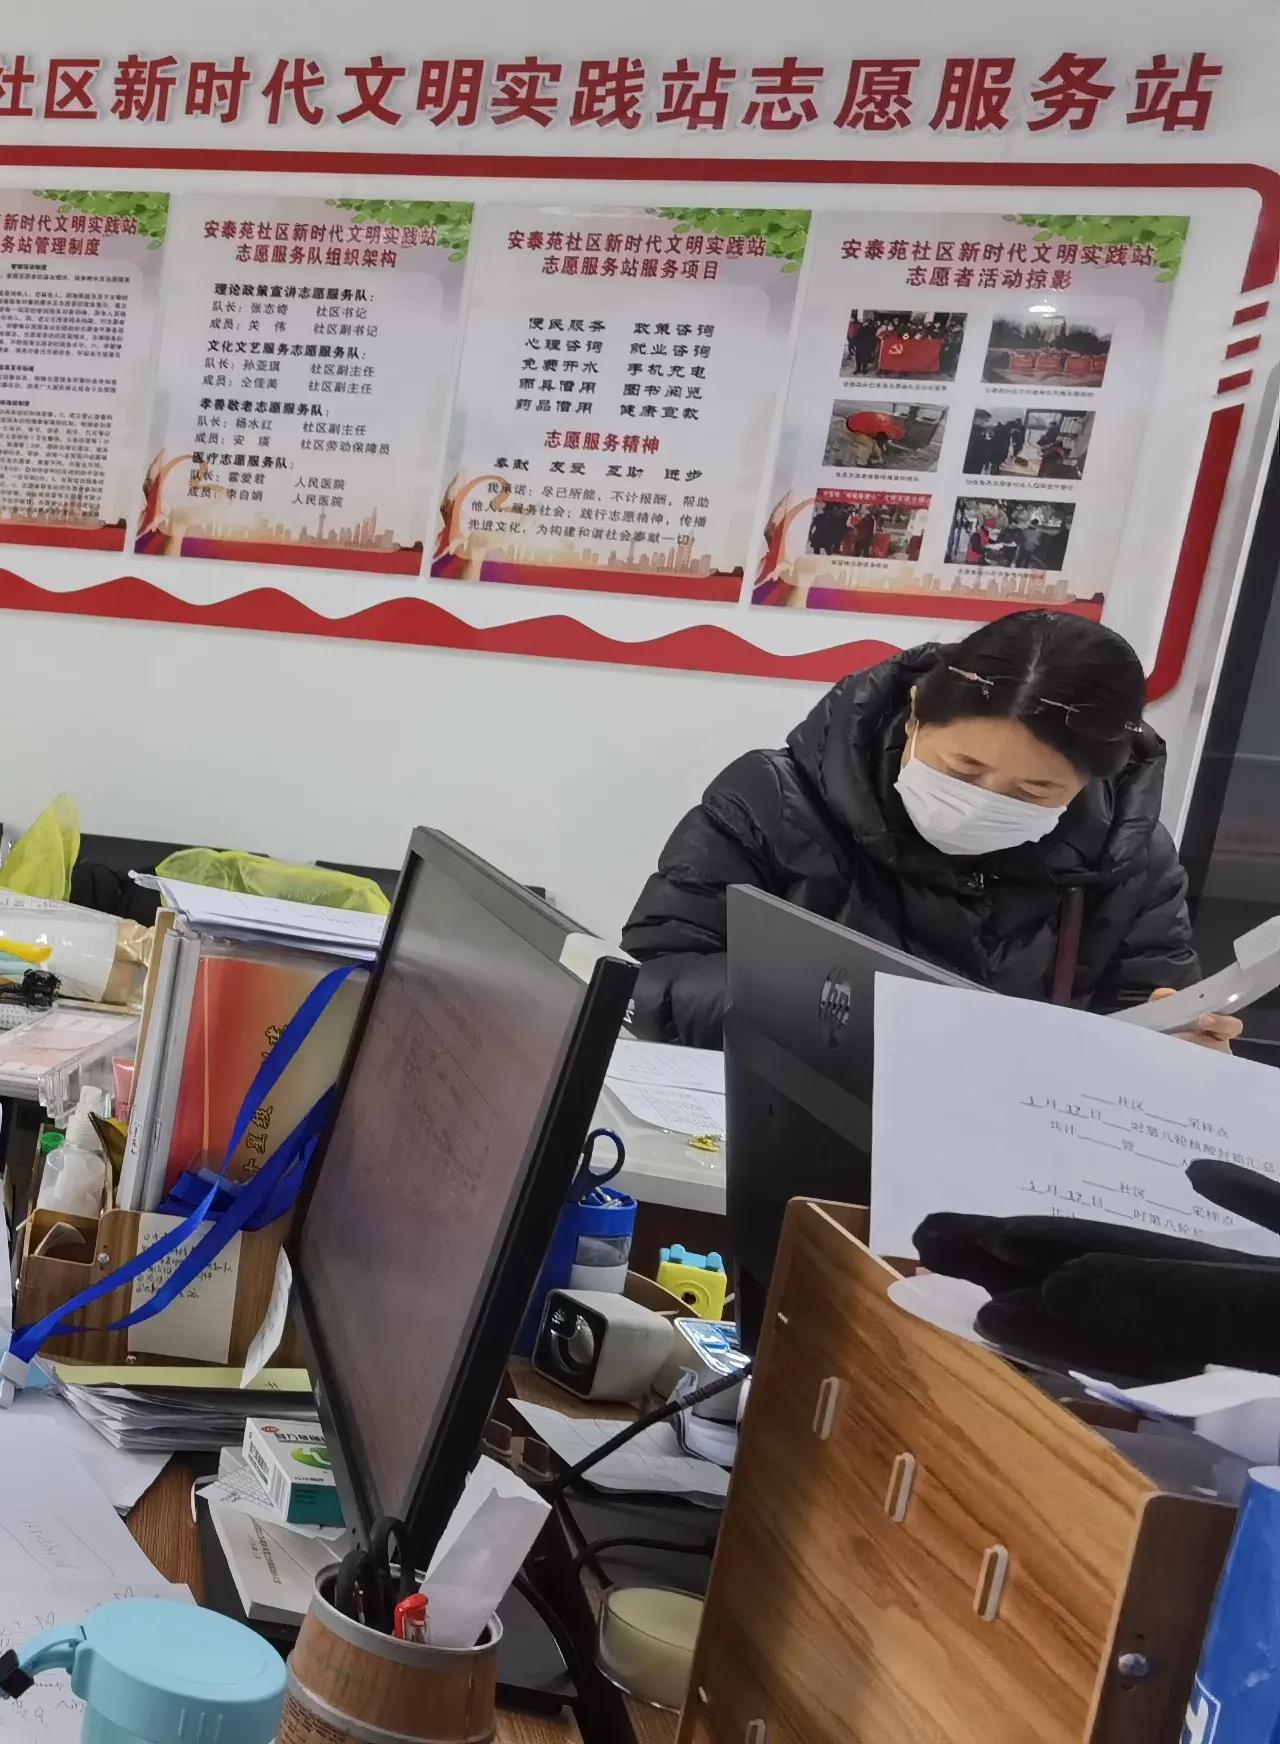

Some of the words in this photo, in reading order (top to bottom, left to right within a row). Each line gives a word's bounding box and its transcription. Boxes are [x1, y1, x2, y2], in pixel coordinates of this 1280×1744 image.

[204, 219, 438, 248] 安泰苑社区新时代文明实践站
[507, 229, 767, 257] 安泰苑社区新时代文明实践站
[235, 243, 397, 268] 志愿服务队组织架构
[840, 238, 1152, 267] 安泰苑社区新时代文明实践站
[541, 254, 720, 280] 志愿服务站服务项目
[905, 265, 1073, 291] 志愿者活动掠影
[316, 304, 368, 320] 社区书记
[528, 317, 606, 333] 便民服务
[633, 322, 715, 338] 政策咨询
[525, 337, 603, 354] 心理咨询
[630, 342, 711, 359] 就业咨询
[310, 362, 376, 378] 社区副主任
[521, 357, 599, 374] 免费开水
[627, 362, 707, 380] 手机充电
[308, 379, 373, 395] 社区副主任
[623, 383, 703, 400] 图书阅览
[302, 421, 367, 437] 社区副主任
[543, 428, 660, 455] 志愿服务精神
[494, 456, 529, 472] 奉献
[549, 461, 587, 476] 友爱
[605, 464, 644, 479] 互助
[664, 467, 703, 483] 进步
[294, 476, 346, 491] 人民医院
[291, 492, 344, 508] 人民医院
